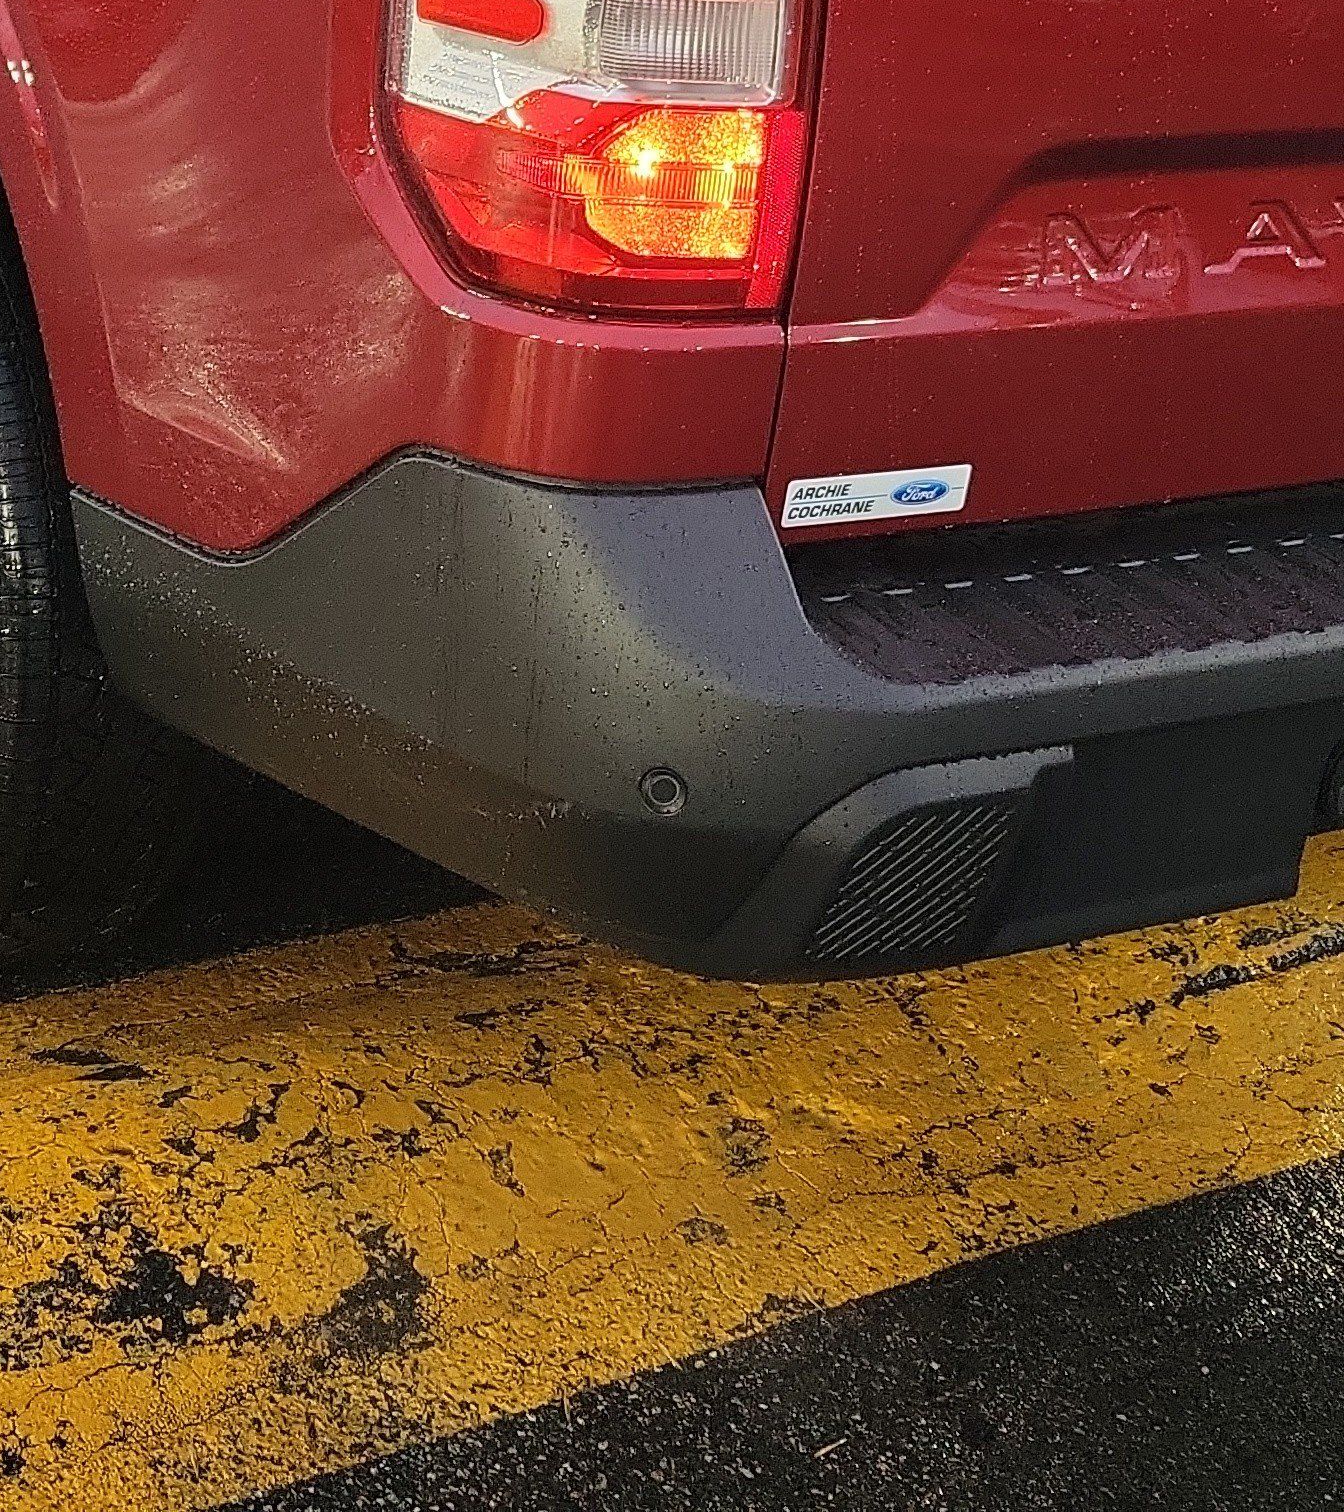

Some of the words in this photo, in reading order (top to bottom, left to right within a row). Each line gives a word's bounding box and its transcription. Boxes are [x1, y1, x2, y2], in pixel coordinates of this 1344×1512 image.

[792, 482, 853, 502] ARCHIE
[900, 486, 939, 503] Ford
[787, 500, 875, 520] COCHRANE
